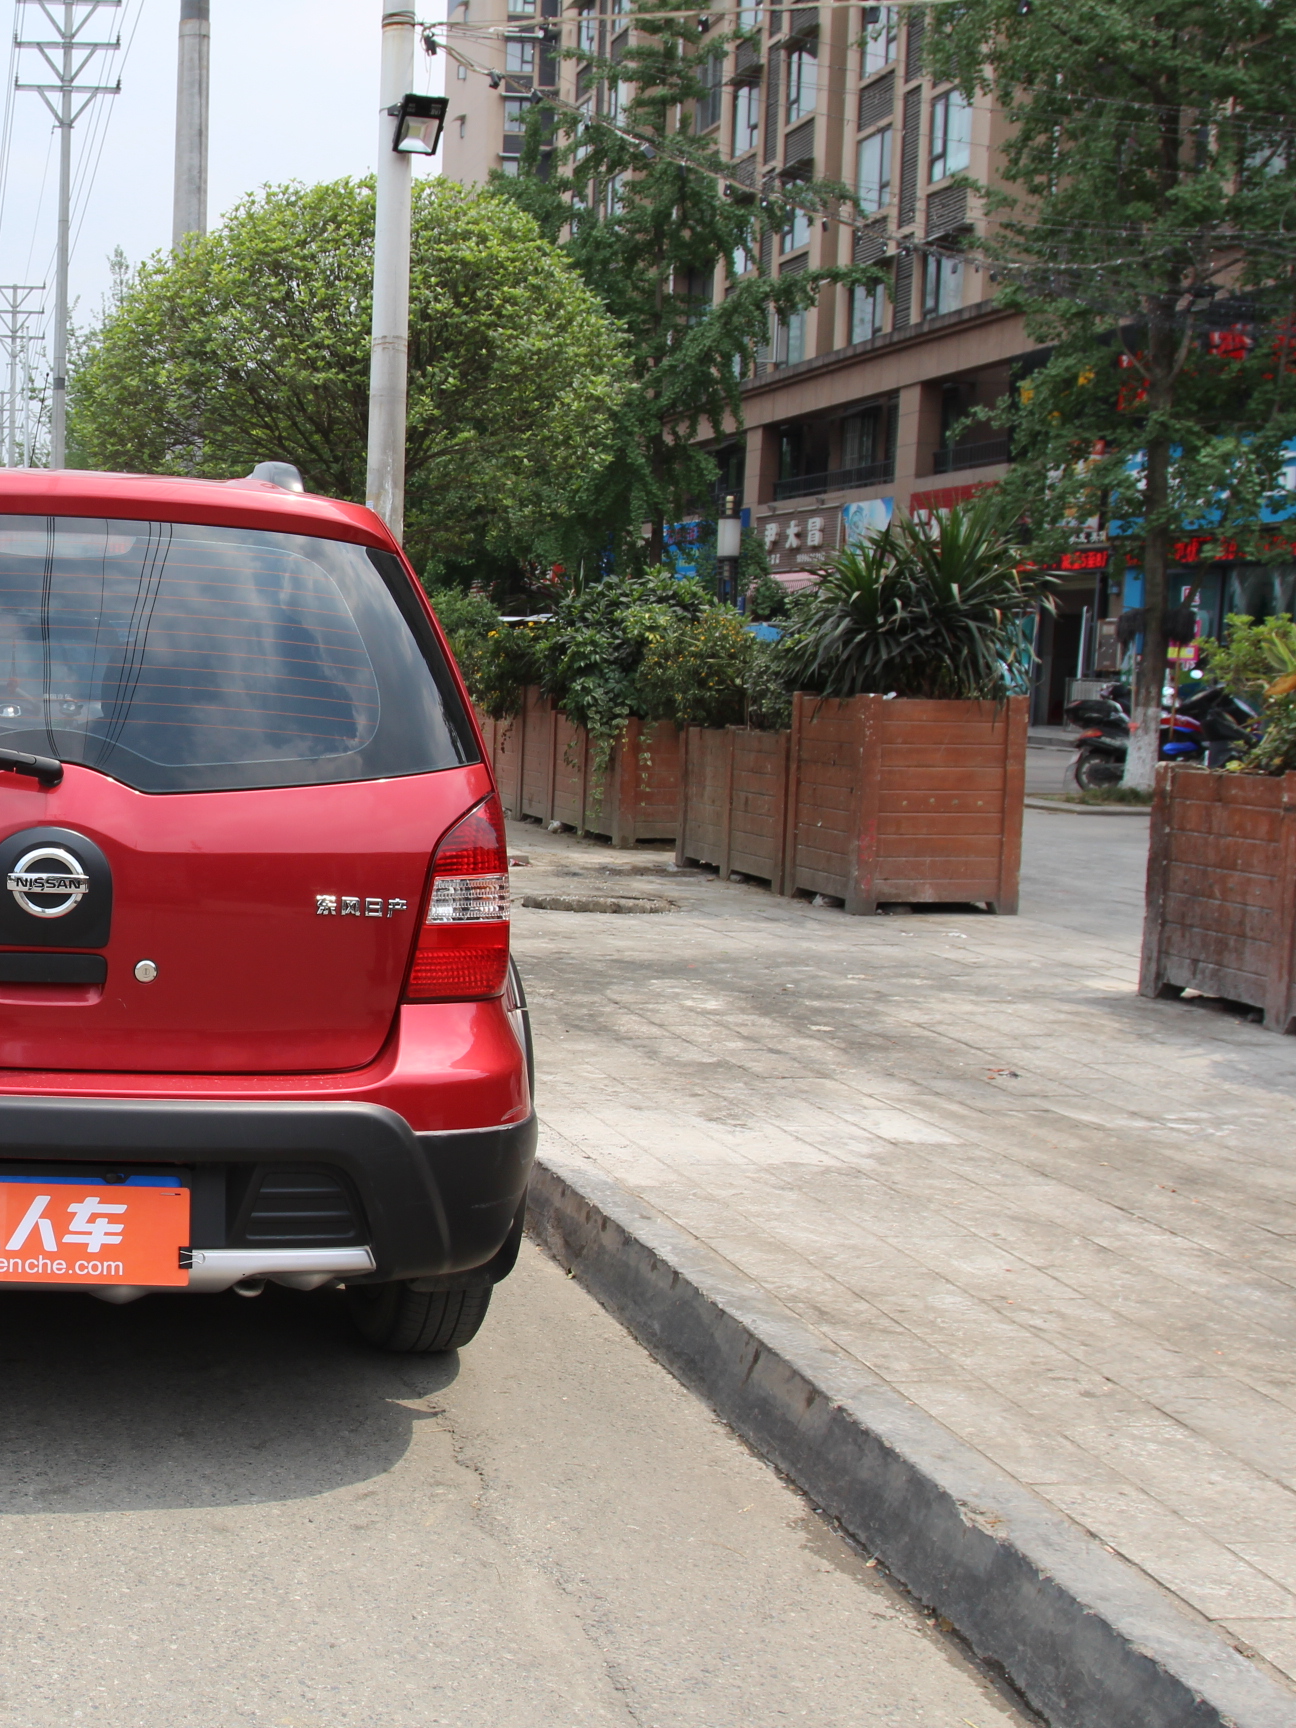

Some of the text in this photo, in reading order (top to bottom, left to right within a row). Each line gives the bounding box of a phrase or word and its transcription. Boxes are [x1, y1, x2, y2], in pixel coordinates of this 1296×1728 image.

[15, 877, 82, 890] NISSAN
[316, 895, 407, 918] 东风日产
